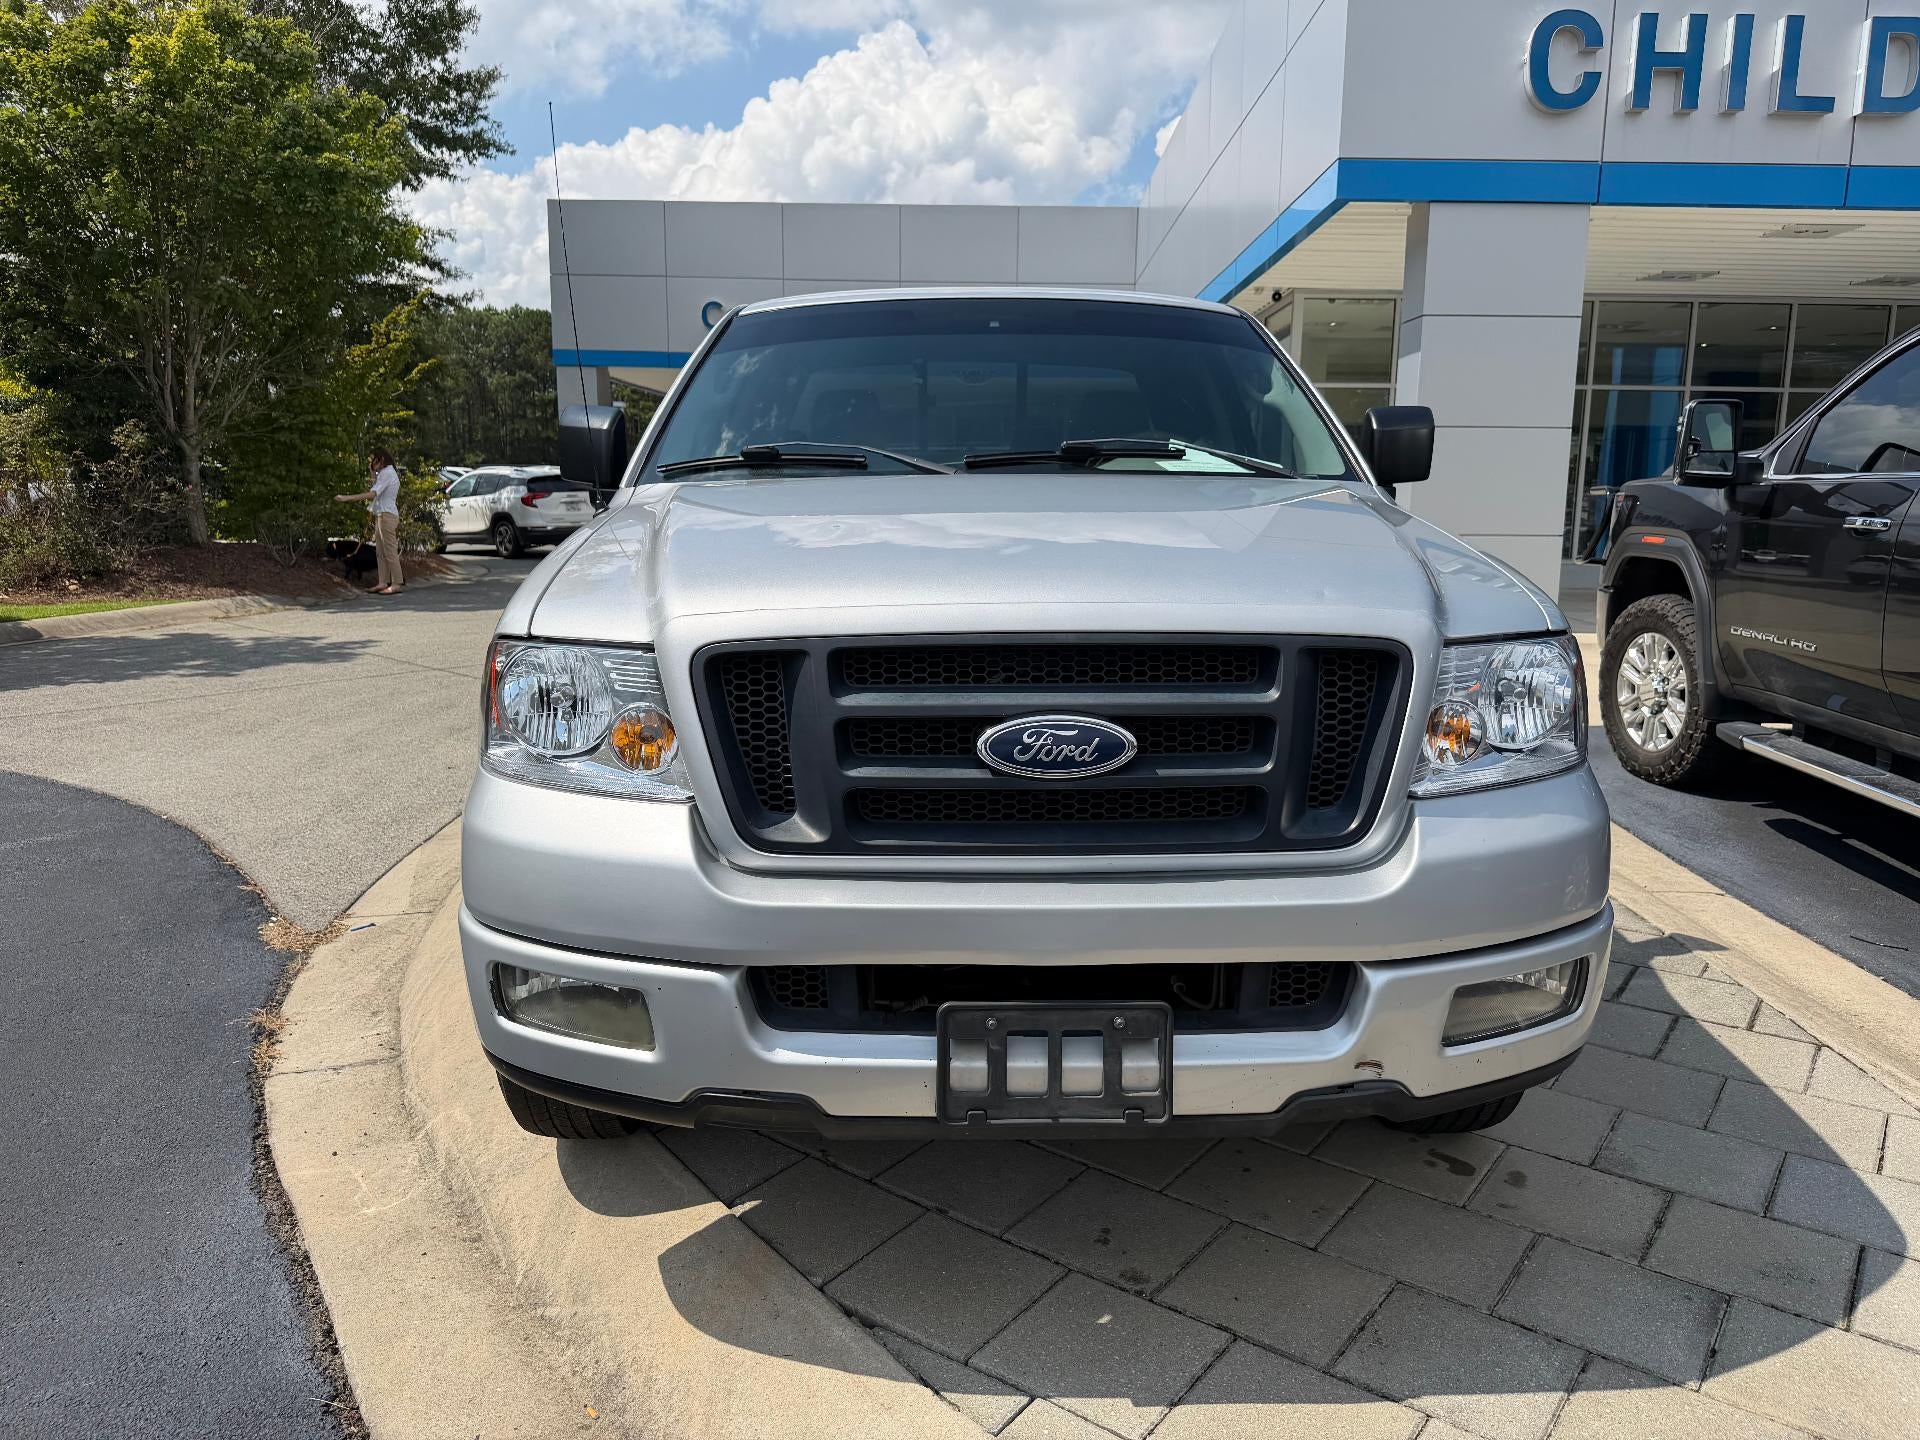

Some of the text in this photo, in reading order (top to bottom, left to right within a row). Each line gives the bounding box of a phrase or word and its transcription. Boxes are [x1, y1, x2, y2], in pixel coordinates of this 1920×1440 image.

[1527, 9, 1920, 114] CHILD
[1730, 626, 1817, 652] DENALI HD
[1014, 728, 1100, 762] Ford
